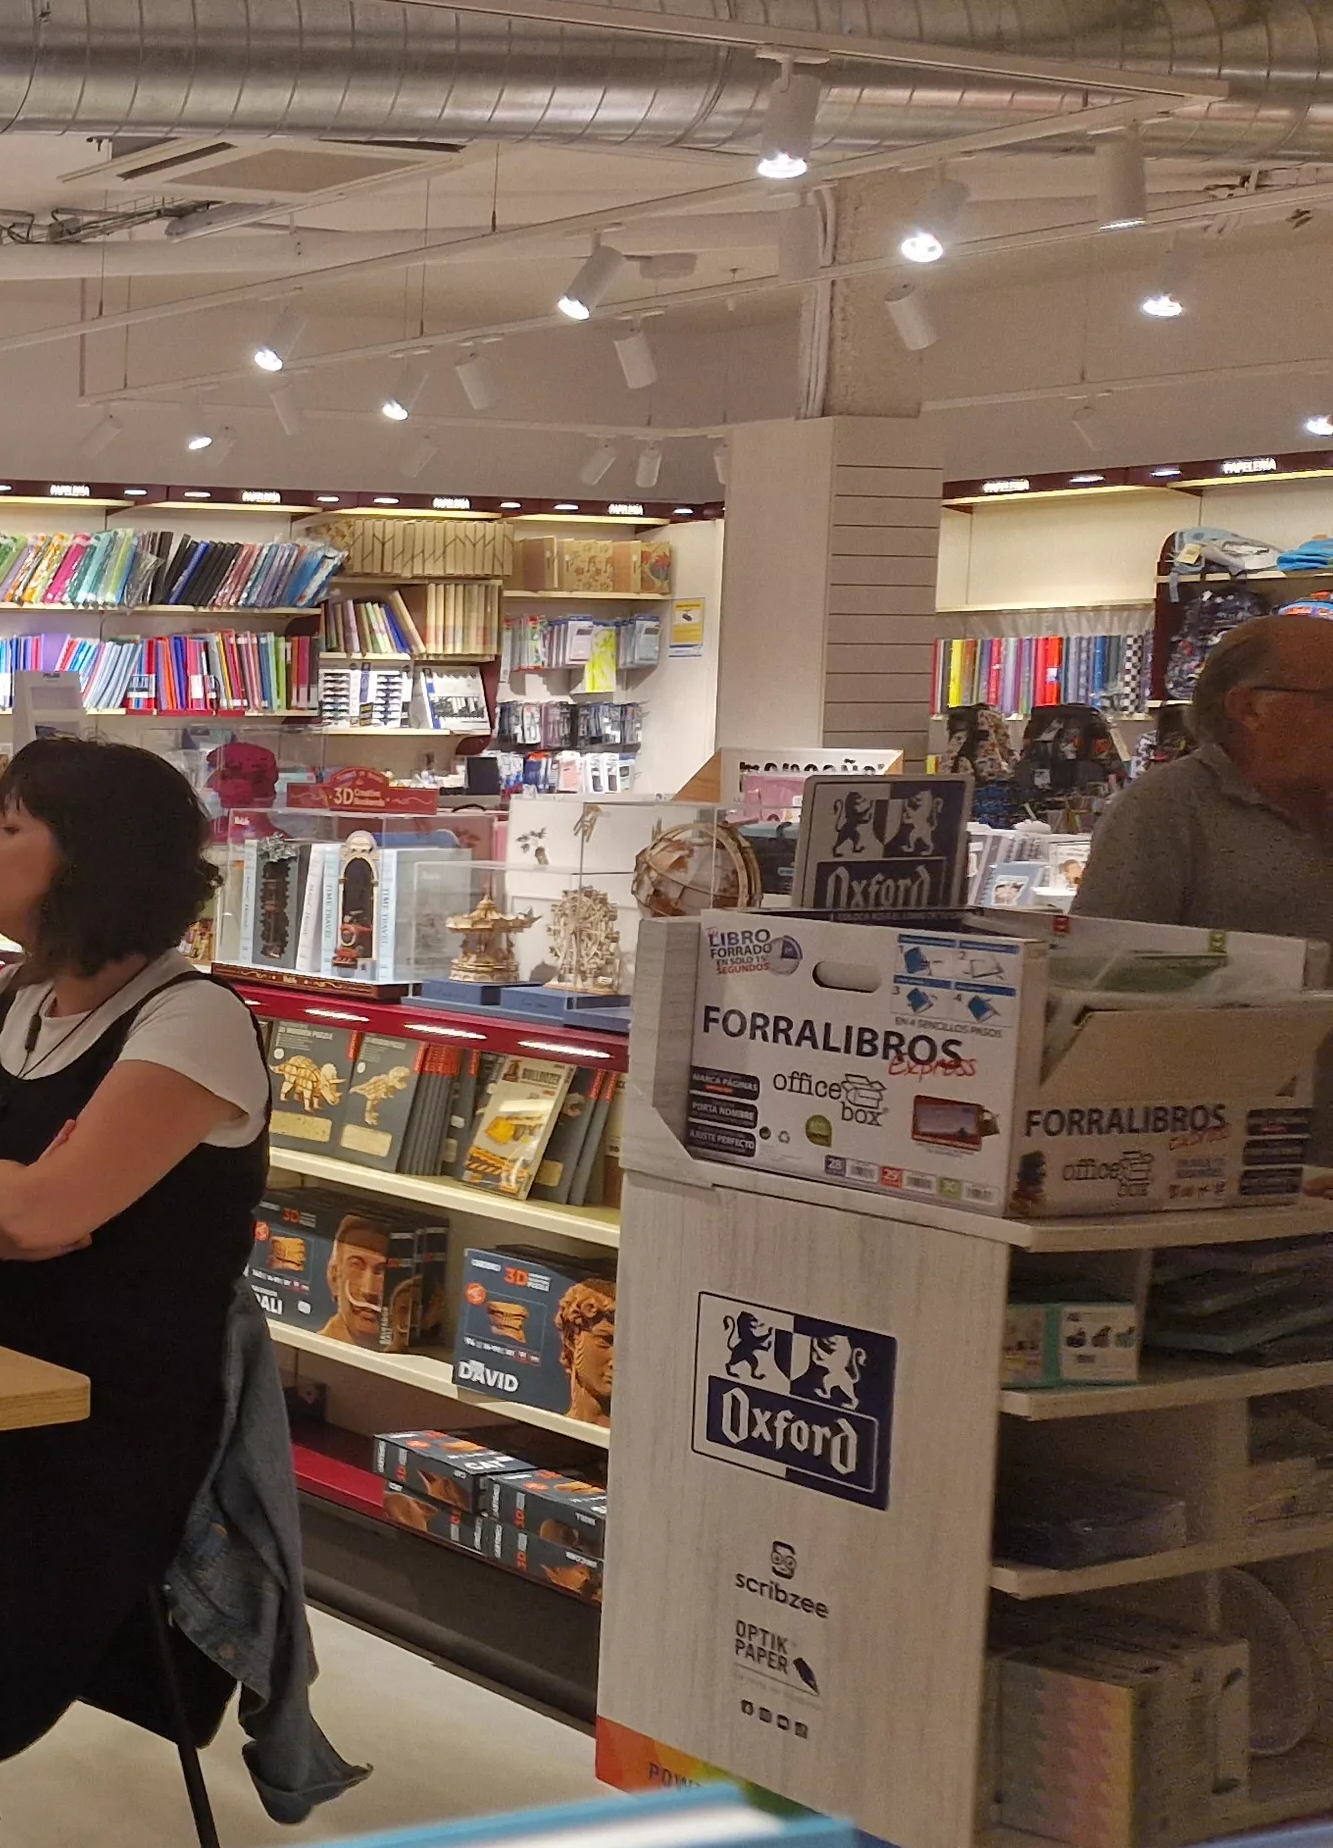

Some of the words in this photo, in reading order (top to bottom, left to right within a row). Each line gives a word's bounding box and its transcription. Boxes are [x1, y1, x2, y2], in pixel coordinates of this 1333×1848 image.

[334, 787, 354, 805] 3D
[826, 864, 931, 909] Oxford
[709, 929, 770, 947] LIBRO
[710, 943, 773, 960] FORRADO
[717, 962, 770, 975] SEGUNDOS
[703, 1005, 963, 1067] FORRALIBROS
[773, 1070, 842, 1101] office
[718, 1106, 755, 1121] NOMBRE
[841, 1101, 883, 1127] box
[1024, 1103, 1226, 1138] FORRALIBROS
[717, 1135, 755, 1149] PERFECTO
[503, 1266, 529, 1287] 3D
[458, 1360, 520, 1393] DAVID
[722, 1387, 858, 1475] Oxford
[735, 1572, 829, 1619] scribzee
[735, 1619, 789, 1655] OPTIK
[735, 1638, 789, 1675] PAPER
